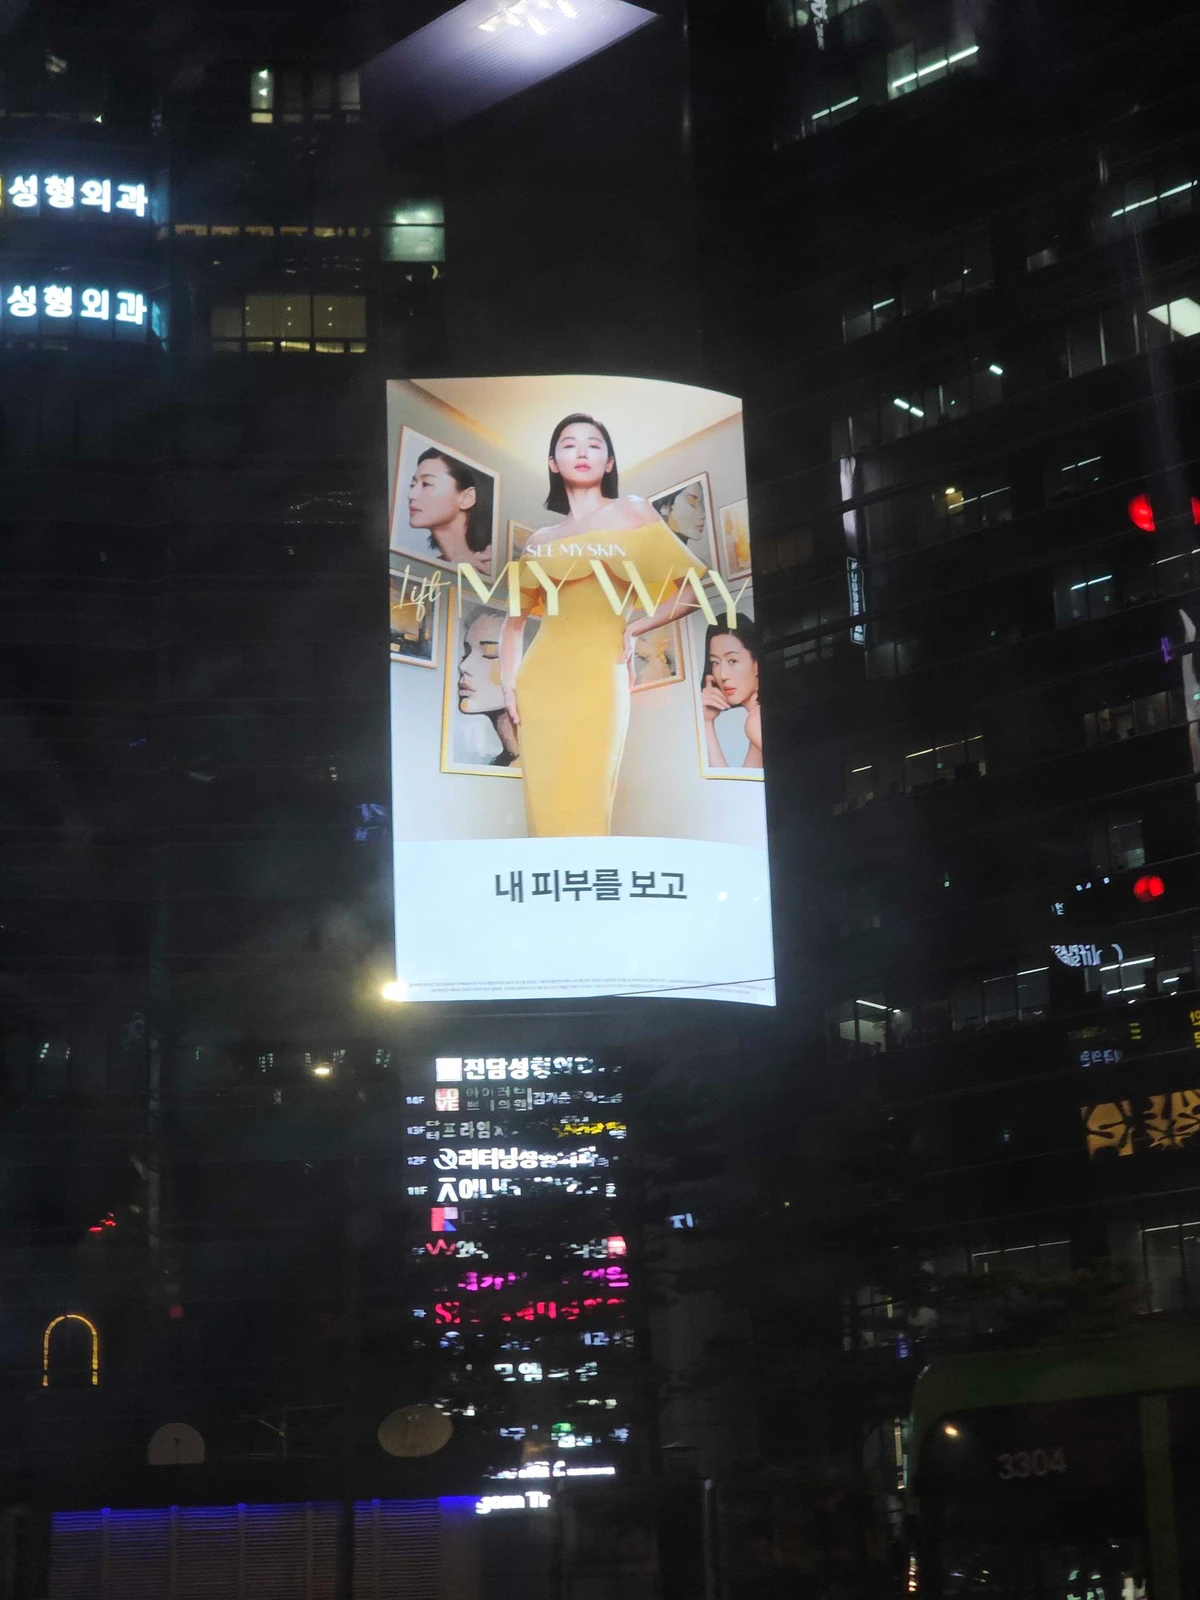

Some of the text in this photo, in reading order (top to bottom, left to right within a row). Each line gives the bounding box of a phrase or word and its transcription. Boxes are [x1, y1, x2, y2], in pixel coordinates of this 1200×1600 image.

[8, 174, 148, 217] 성형외과
[7, 284, 148, 325] 성형외과
[526, 543, 627, 557] SEE MY SKIN
[456, 559, 752, 629] MY WAY
[495, 869, 688, 903] 내 피부를 보고
[997, 1448, 1068, 1480] 3304
